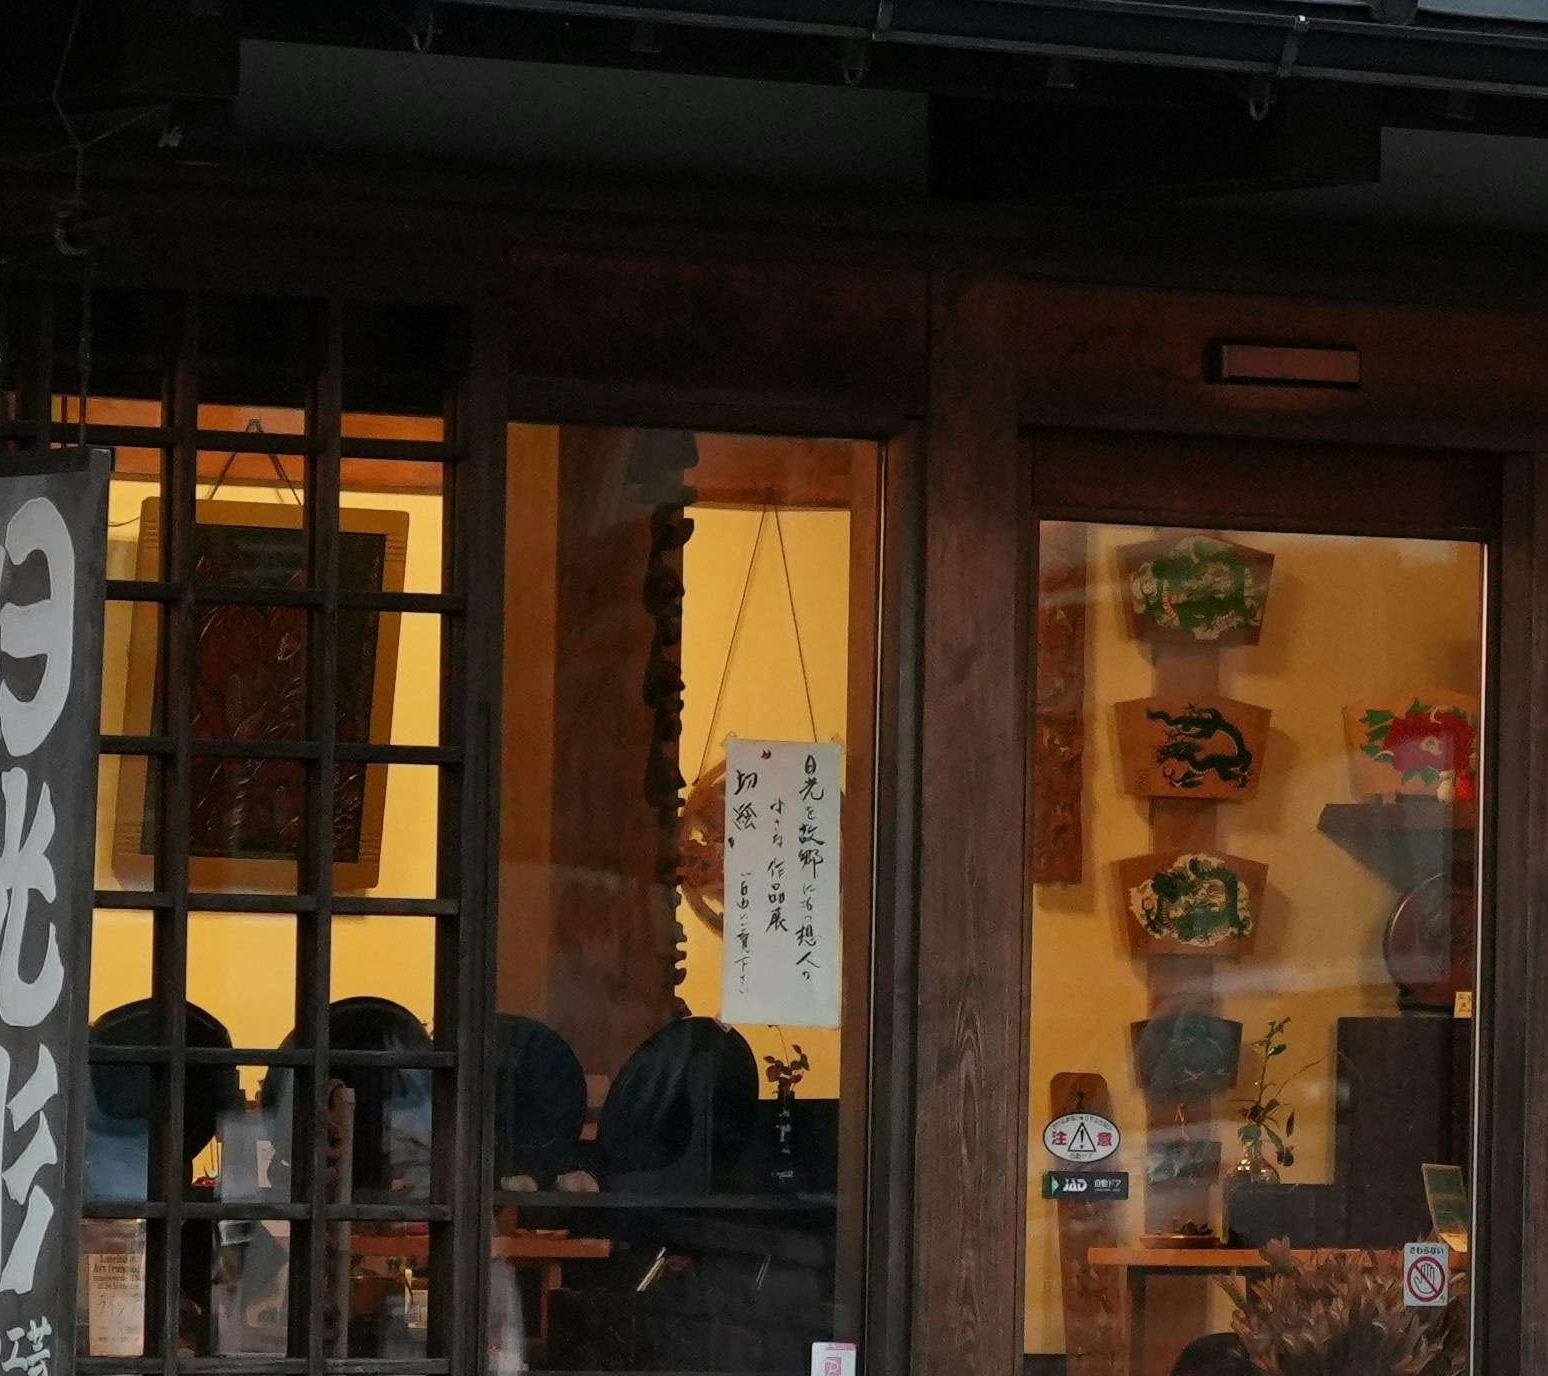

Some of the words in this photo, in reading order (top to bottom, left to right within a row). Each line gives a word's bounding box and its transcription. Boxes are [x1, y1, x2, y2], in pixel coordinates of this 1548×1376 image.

[1052, 1131, 1067, 1145] 注
[1097, 1132, 1112, 1146] 意
[1409, 1246, 1444, 1255] さわらない
